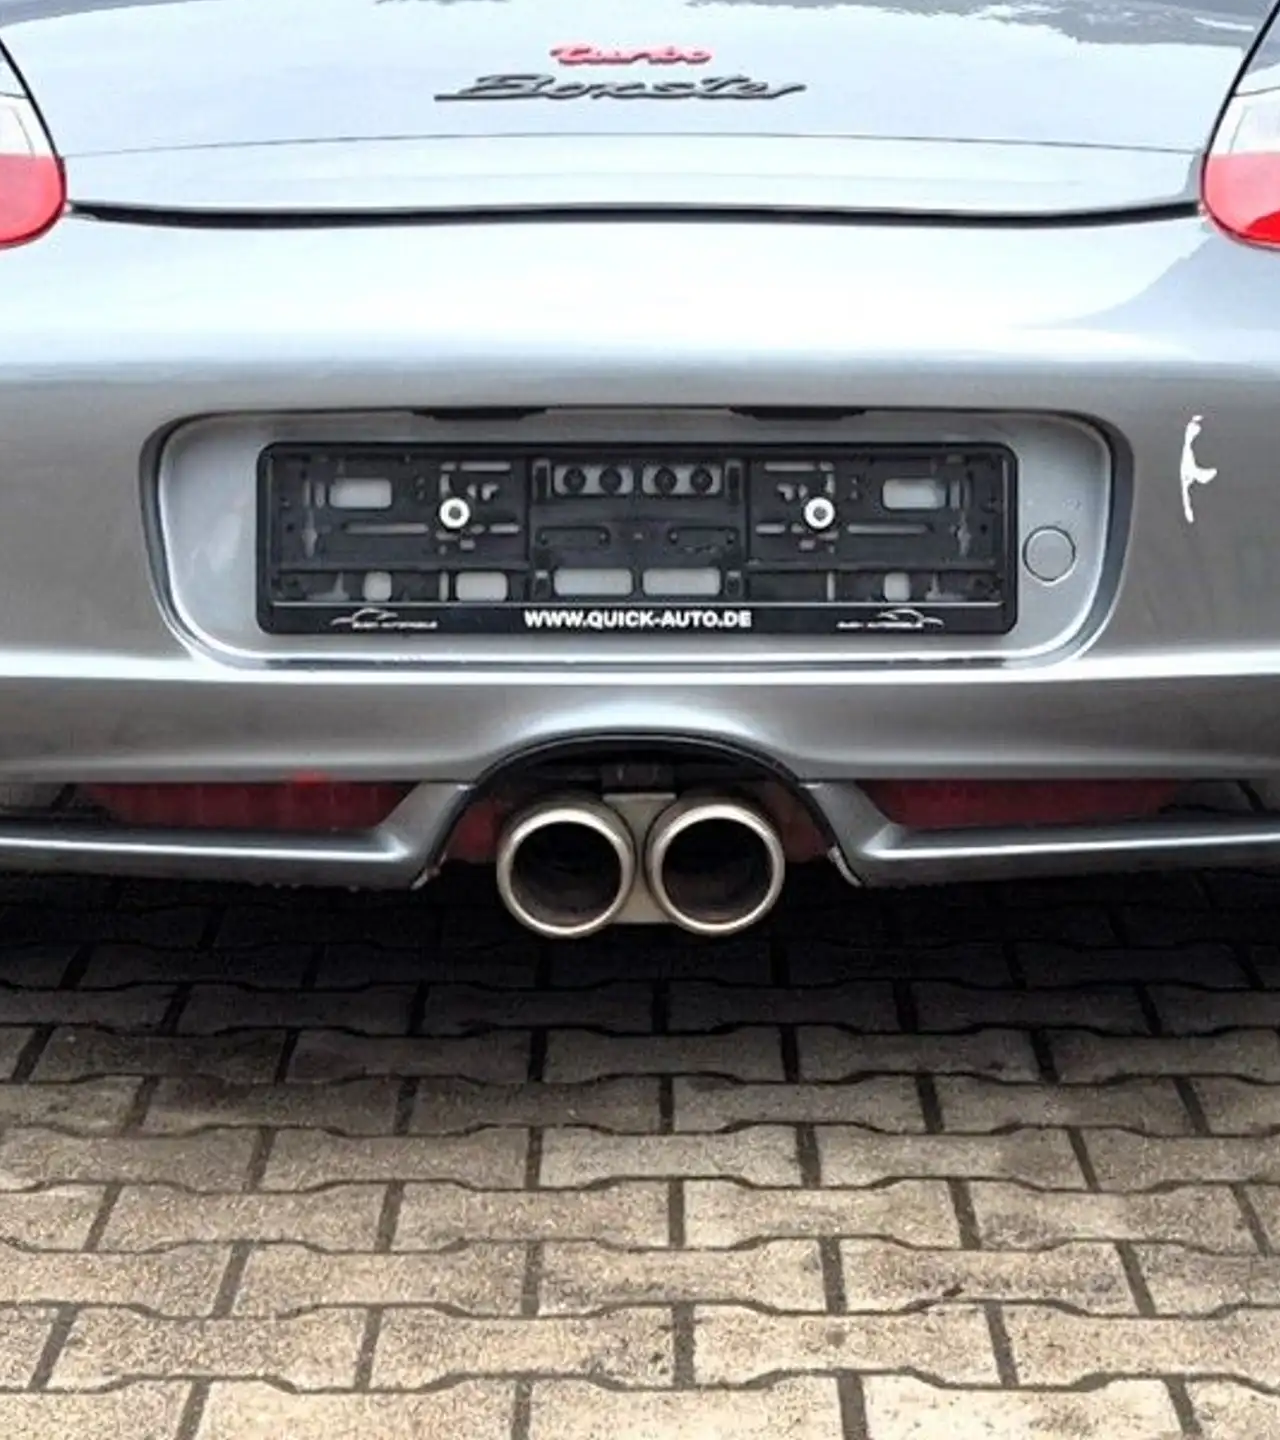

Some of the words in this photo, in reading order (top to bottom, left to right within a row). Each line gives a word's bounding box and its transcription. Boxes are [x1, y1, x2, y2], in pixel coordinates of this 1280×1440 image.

[549, 44, 713, 65] turbo
[434, 73, 807, 101] Boxster
[523, 610, 753, 629] WWW.QUICK-AUTO.DE
